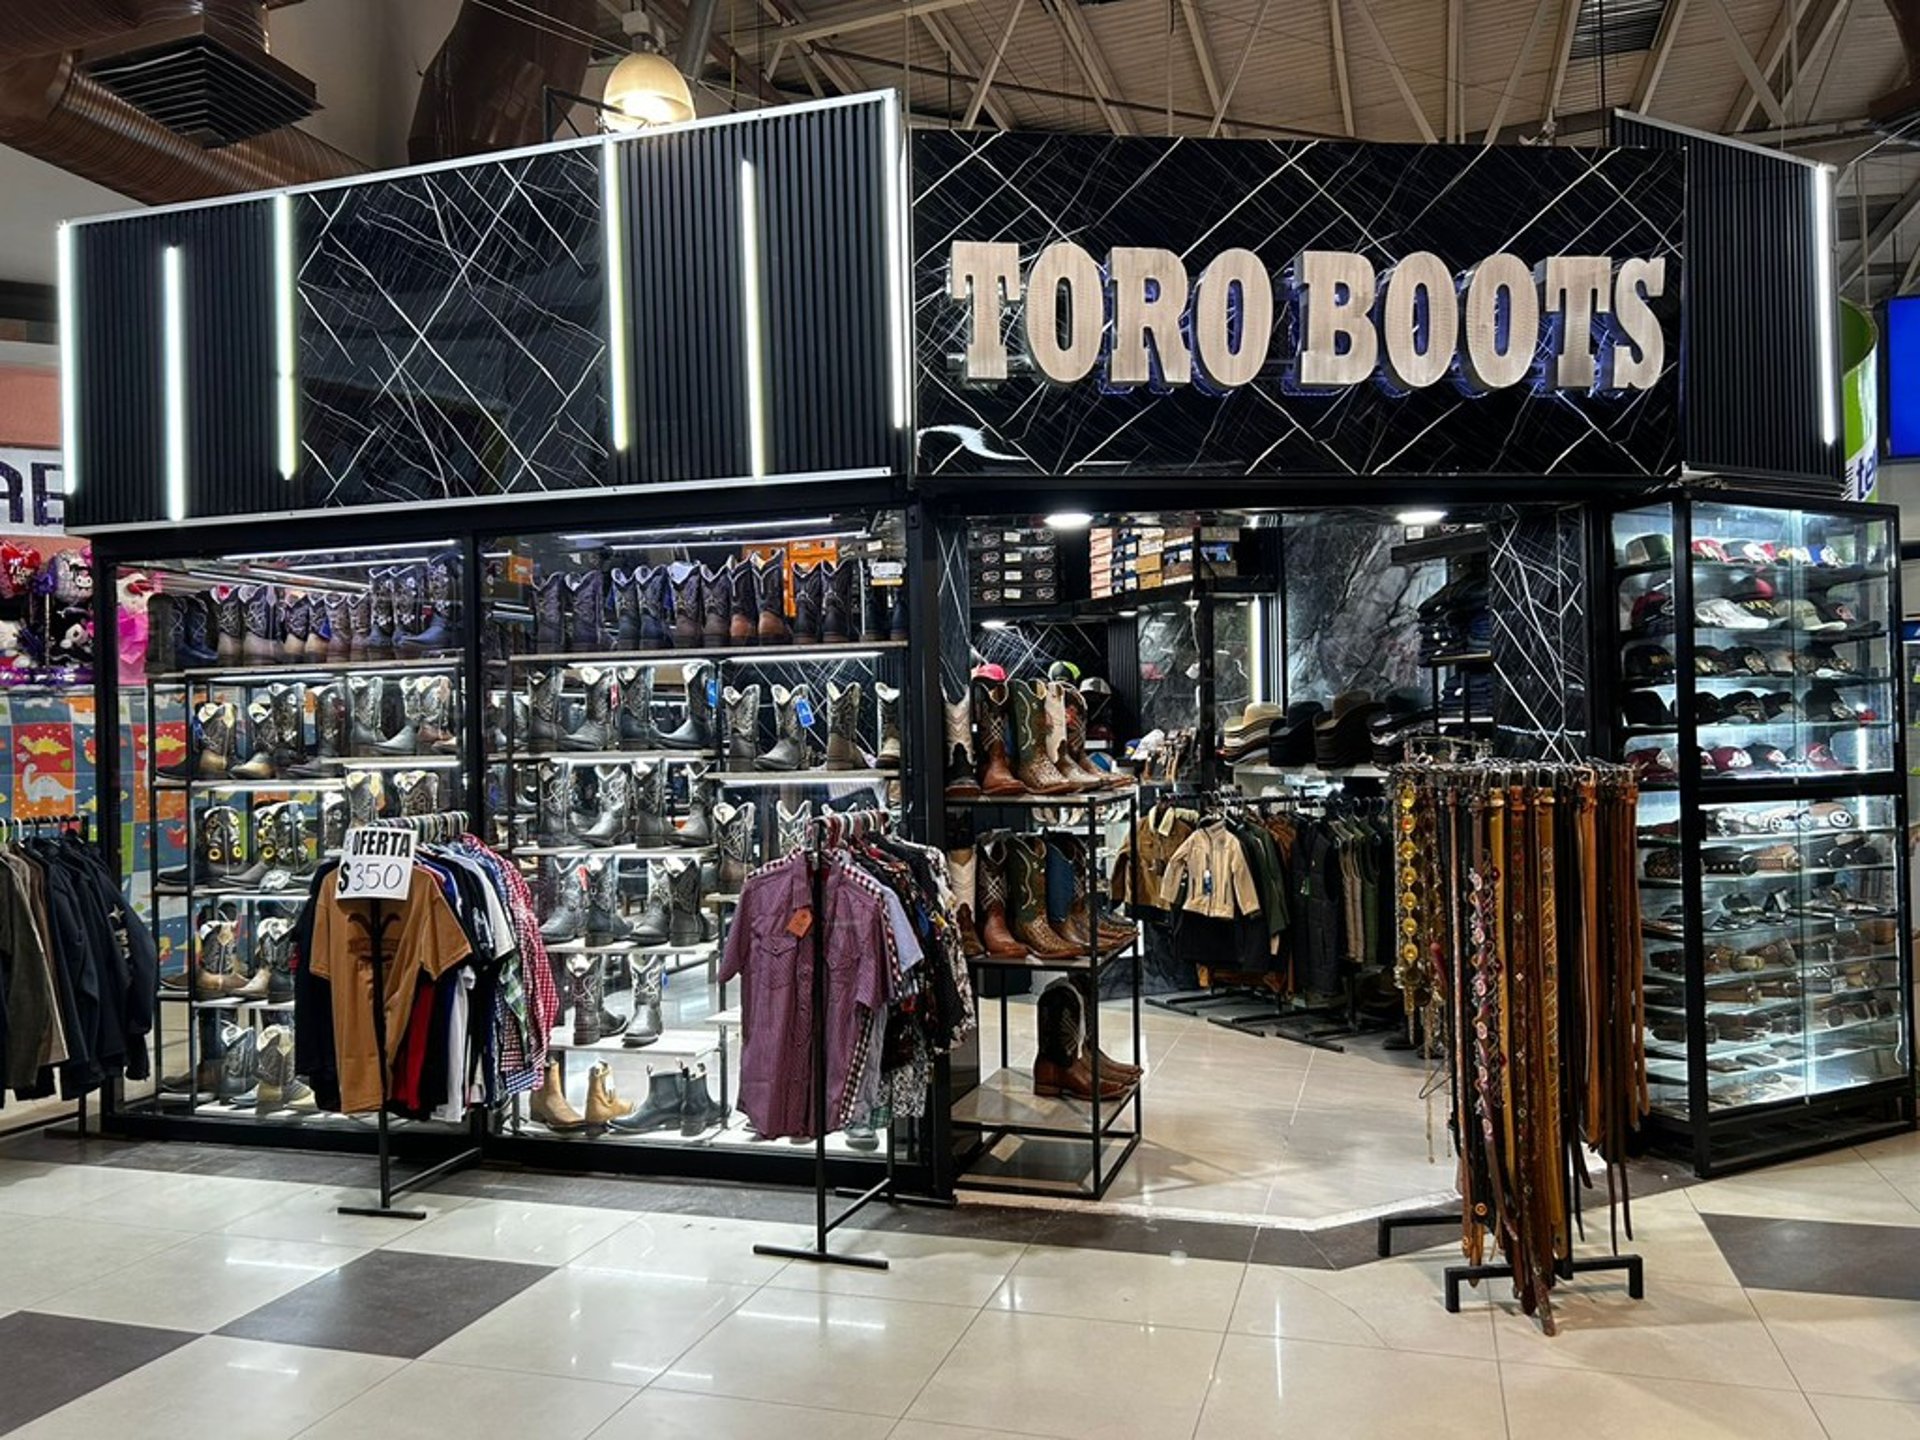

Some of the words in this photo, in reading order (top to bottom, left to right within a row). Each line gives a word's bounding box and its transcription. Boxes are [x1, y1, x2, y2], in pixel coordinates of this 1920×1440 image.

[946, 240, 1273, 387] TORO
[1297, 249, 1666, 390] BOOTS
[352, 830, 411, 857] OFERTA
[338, 861, 403, 894] $350
